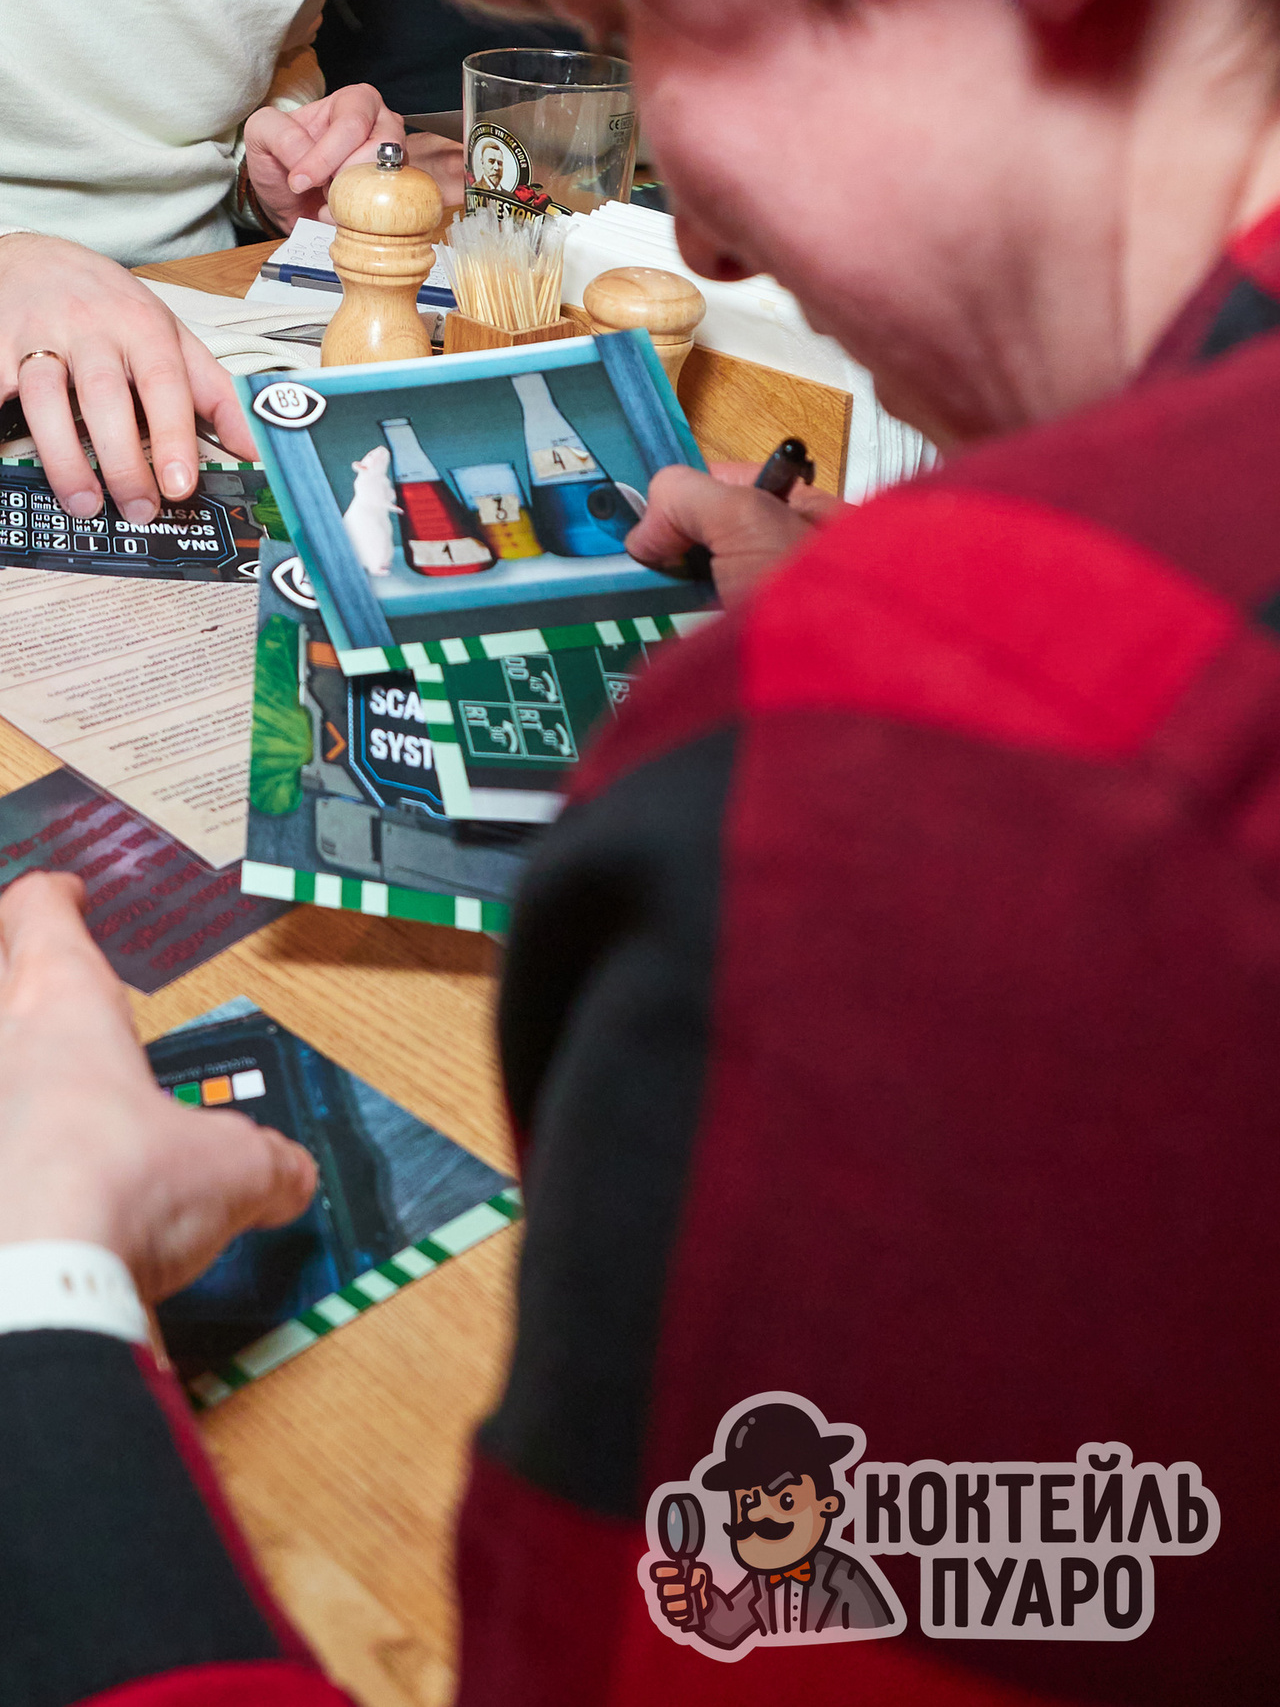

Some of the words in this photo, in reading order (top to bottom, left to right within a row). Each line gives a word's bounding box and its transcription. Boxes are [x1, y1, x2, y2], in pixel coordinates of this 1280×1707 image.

[514, 147, 528, 169] CIDER
[276, 389, 300, 409] B3
[552, 450, 567, 471] 4
[9, 493, 23, 507] 9
[493, 497, 508, 521] 3
[9, 511, 23, 525] 6
[52, 515, 66, 529] 5
[92, 518, 105, 531] 4
[115, 522, 215, 536] SCANNING
[9, 531, 23, 546] 3
[52, 534, 66, 549] 2
[88, 537, 98, 550] 1
[177, 538, 218, 552] DNA
[442, 544, 455, 563] 1
[370, 687, 426, 723] SCA
[370, 728, 432, 770] SYST
